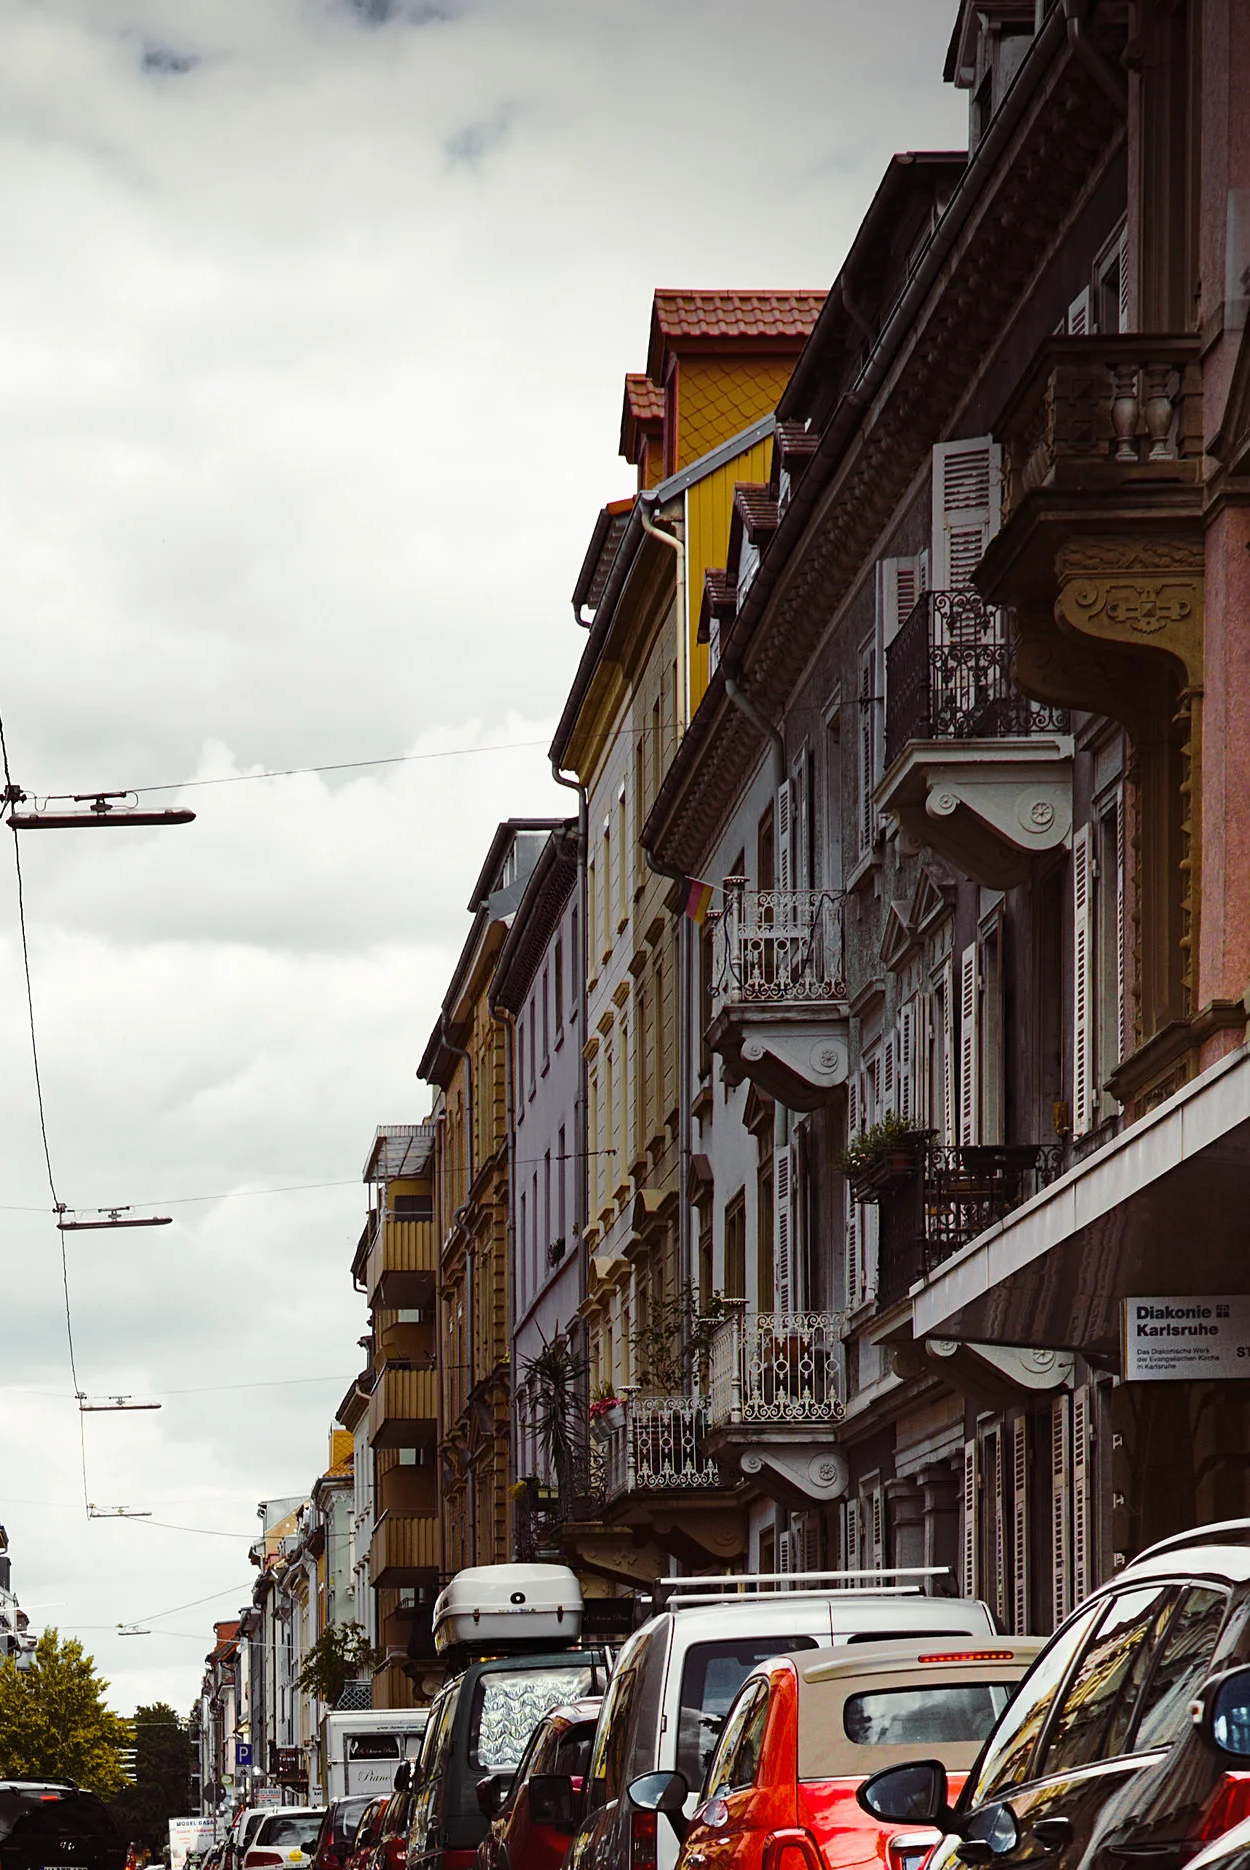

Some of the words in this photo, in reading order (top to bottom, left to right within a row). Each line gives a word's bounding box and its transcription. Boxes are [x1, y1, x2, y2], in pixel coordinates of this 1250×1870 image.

[1136, 1305, 1212, 1319] Diakonie
[1136, 1323, 1219, 1337] Karlsruhe
[239, 1746, 249, 1763] P
